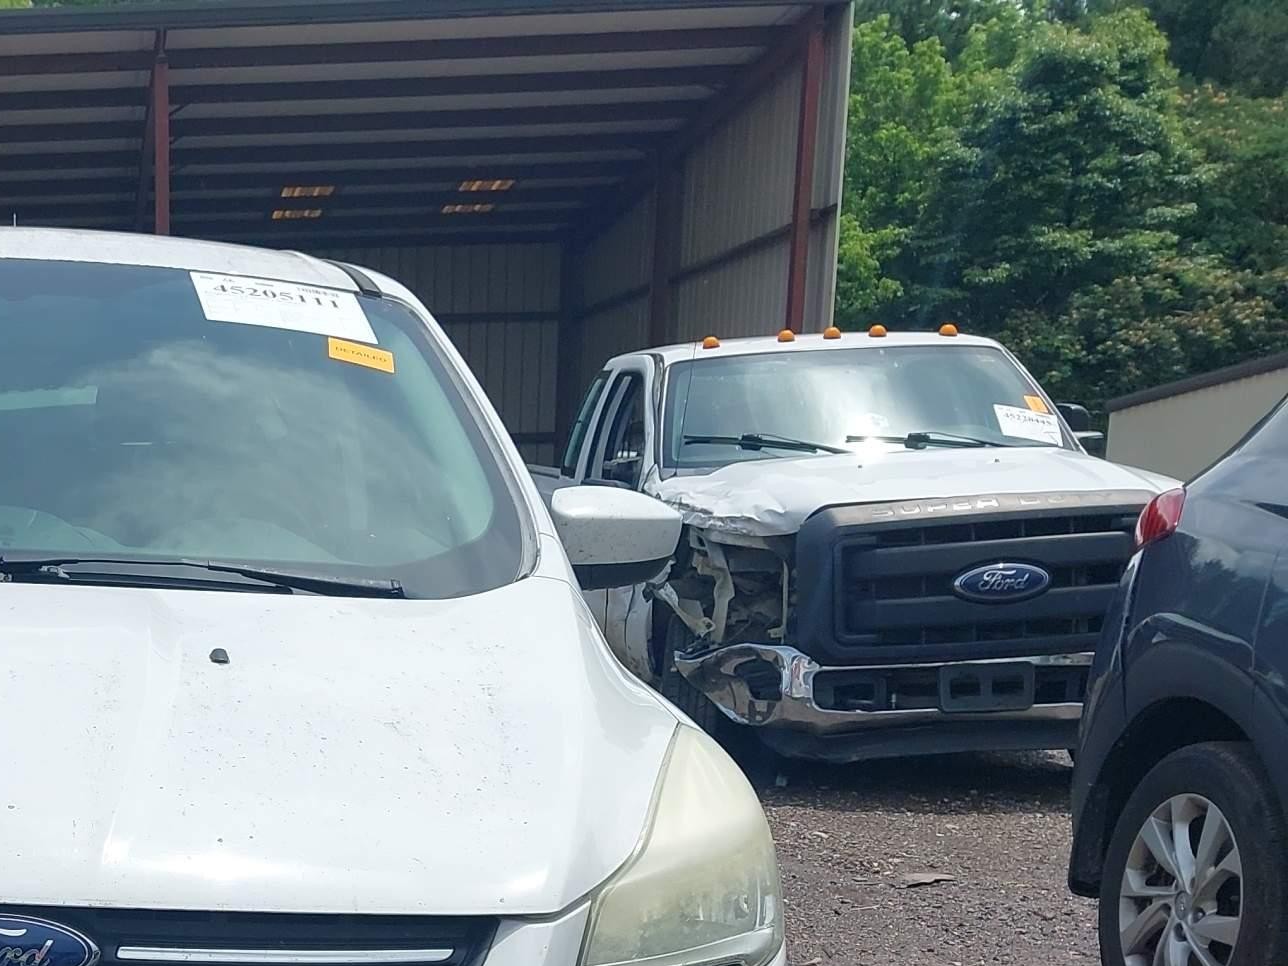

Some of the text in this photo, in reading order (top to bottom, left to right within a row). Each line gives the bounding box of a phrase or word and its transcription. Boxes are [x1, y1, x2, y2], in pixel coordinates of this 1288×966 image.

[212, 284, 340, 309] 45205111
[871, 496, 1000, 518] SUPER
[977, 568, 1031, 591] Ford
